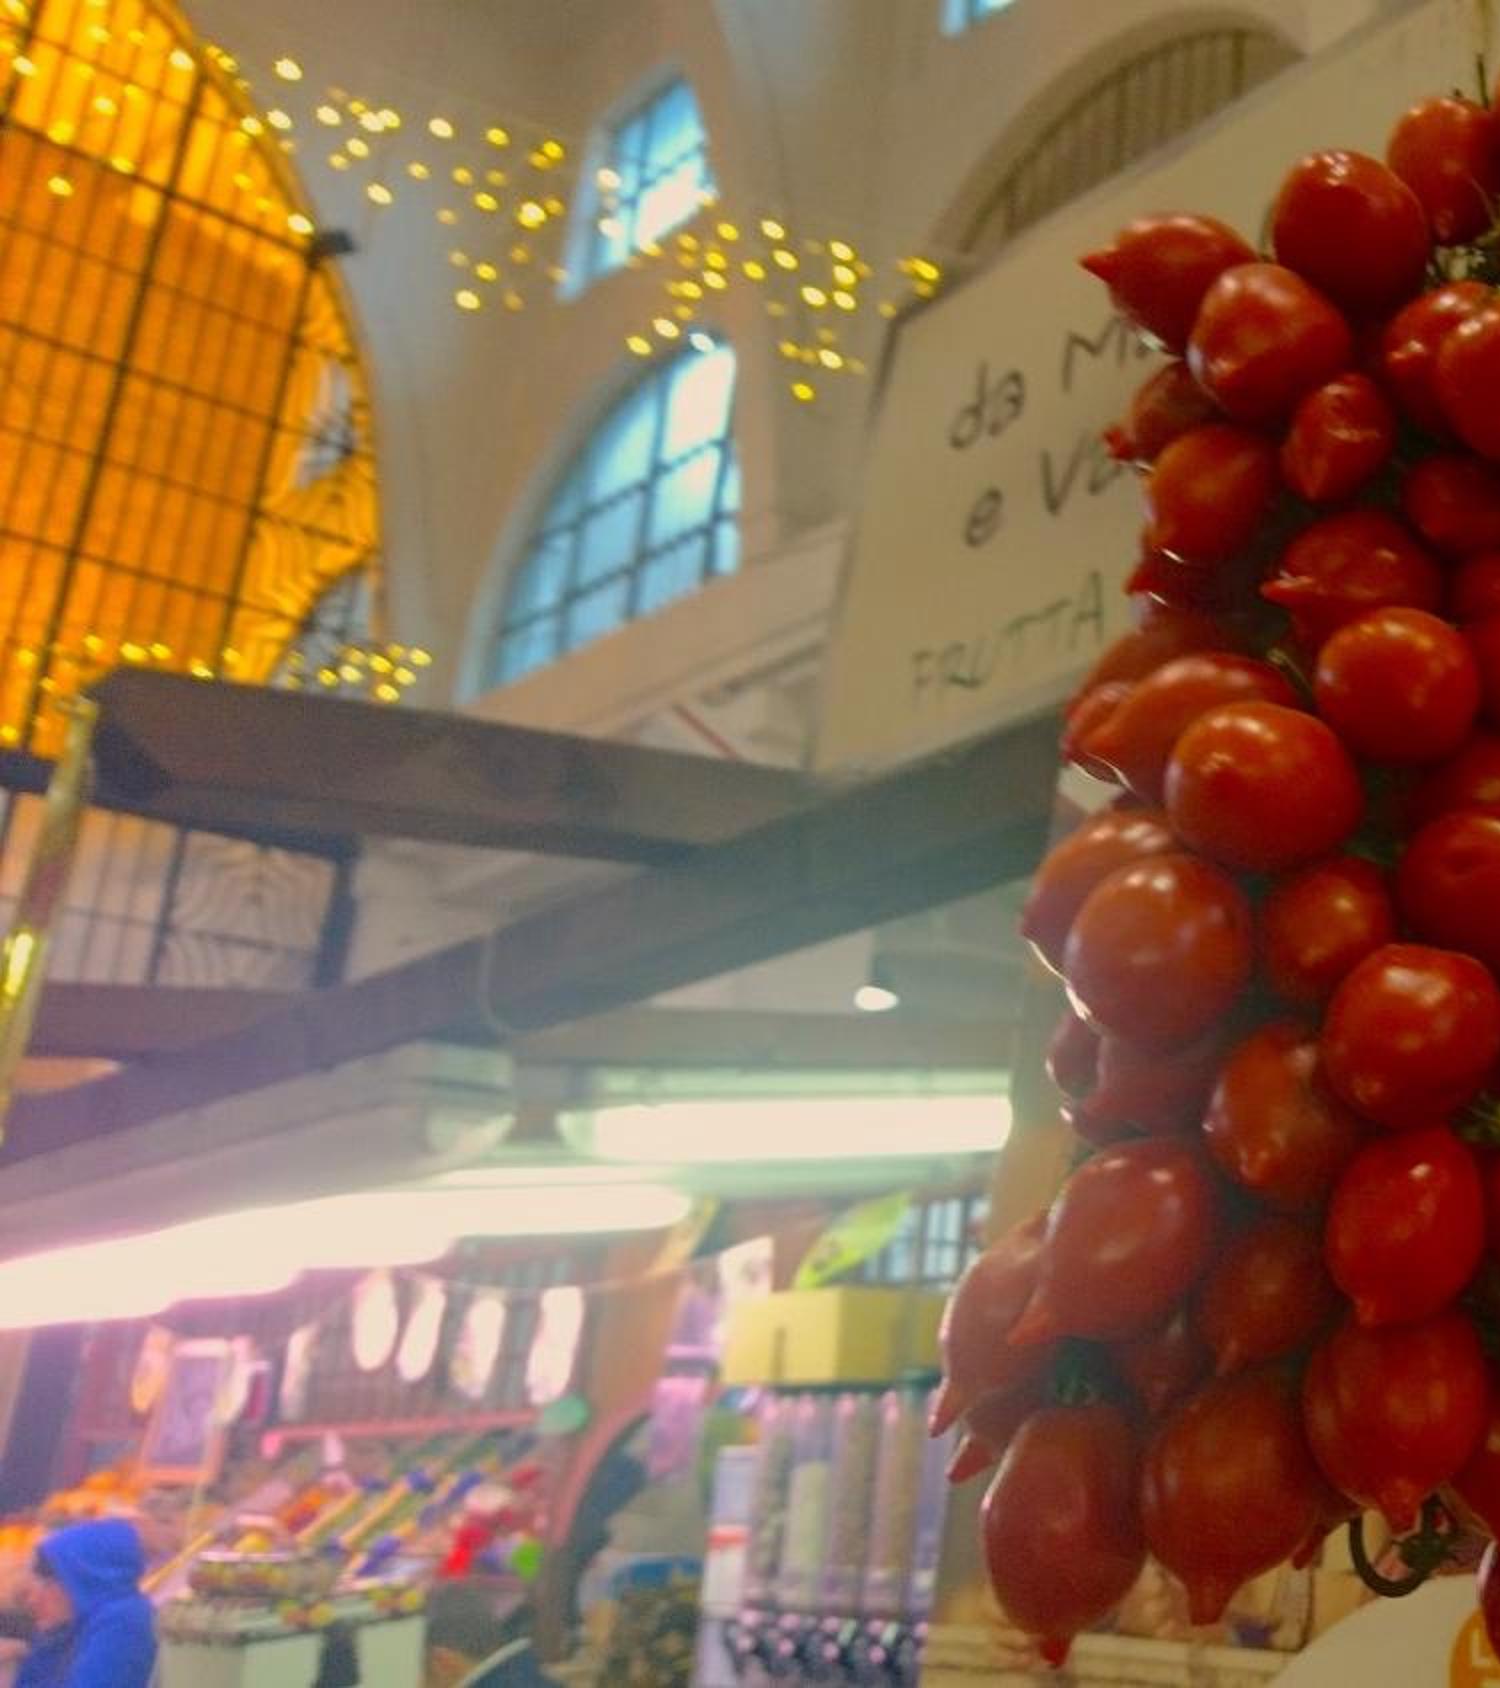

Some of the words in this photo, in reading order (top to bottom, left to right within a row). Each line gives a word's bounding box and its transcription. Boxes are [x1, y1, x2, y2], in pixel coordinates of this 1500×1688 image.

[946, 359, 1026, 449] da
[963, 486, 1004, 549] e
[910, 569, 1105, 702] FRUTTA
